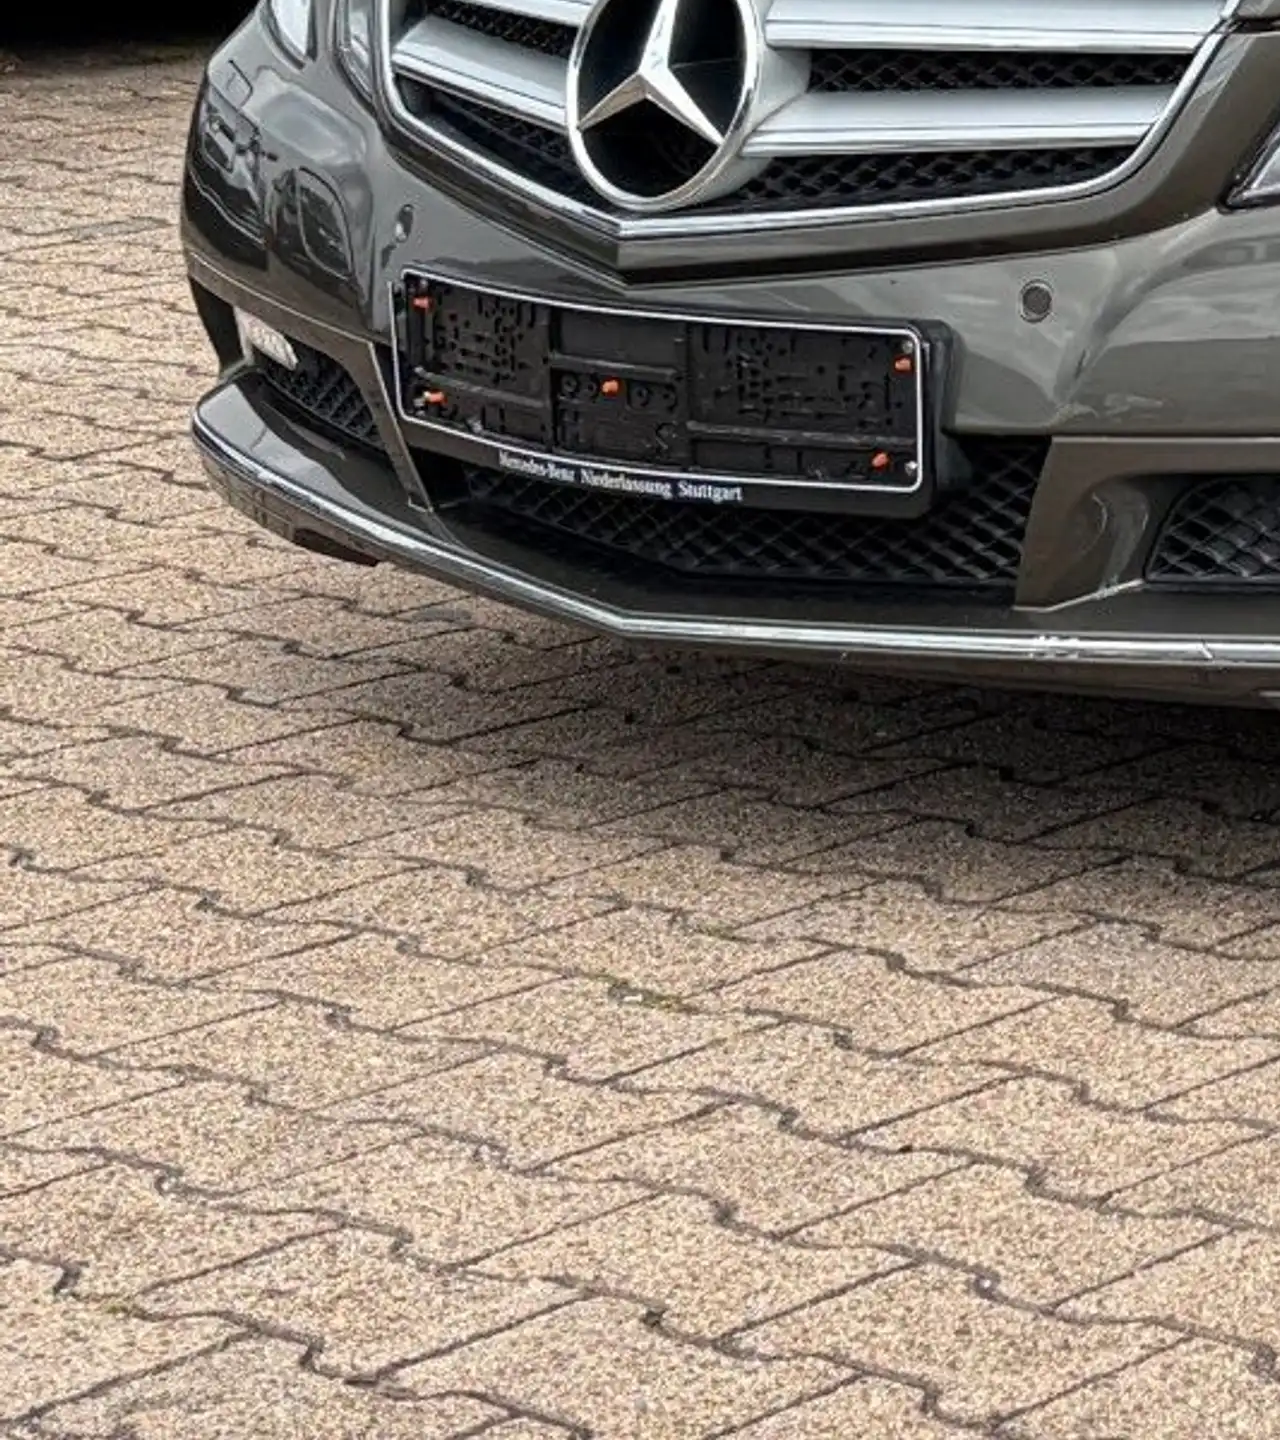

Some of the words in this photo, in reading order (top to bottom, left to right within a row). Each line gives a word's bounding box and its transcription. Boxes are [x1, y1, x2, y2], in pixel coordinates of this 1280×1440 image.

[499, 450, 575, 481] Mercedes-Benz
[580, 469, 672, 498] Niederlassung
[679, 481, 742, 502] Stuttgart
